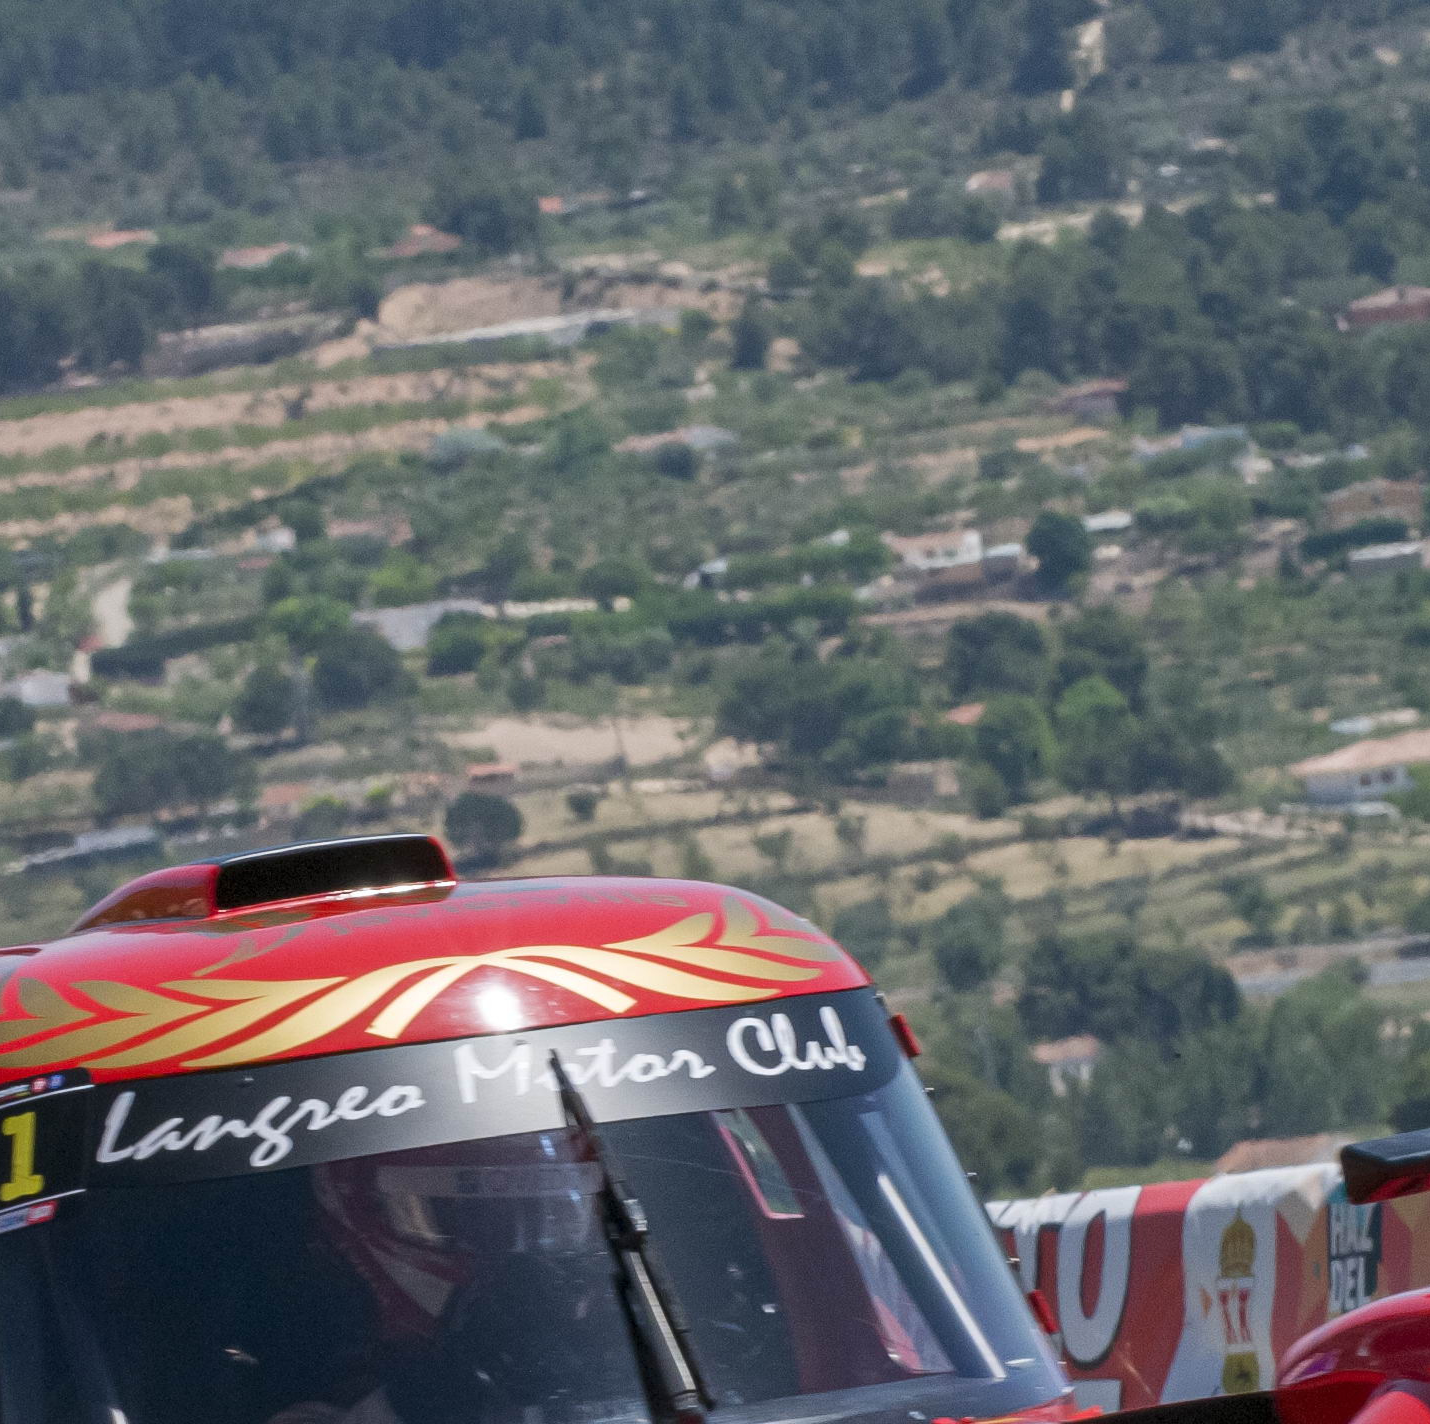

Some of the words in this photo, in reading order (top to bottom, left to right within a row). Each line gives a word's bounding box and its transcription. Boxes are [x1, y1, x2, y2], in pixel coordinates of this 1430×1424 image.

[96, 1084, 428, 1168] Langreo
[726, 1006, 867, 1077] Club
[0, 1111, 45, 1202] 1
